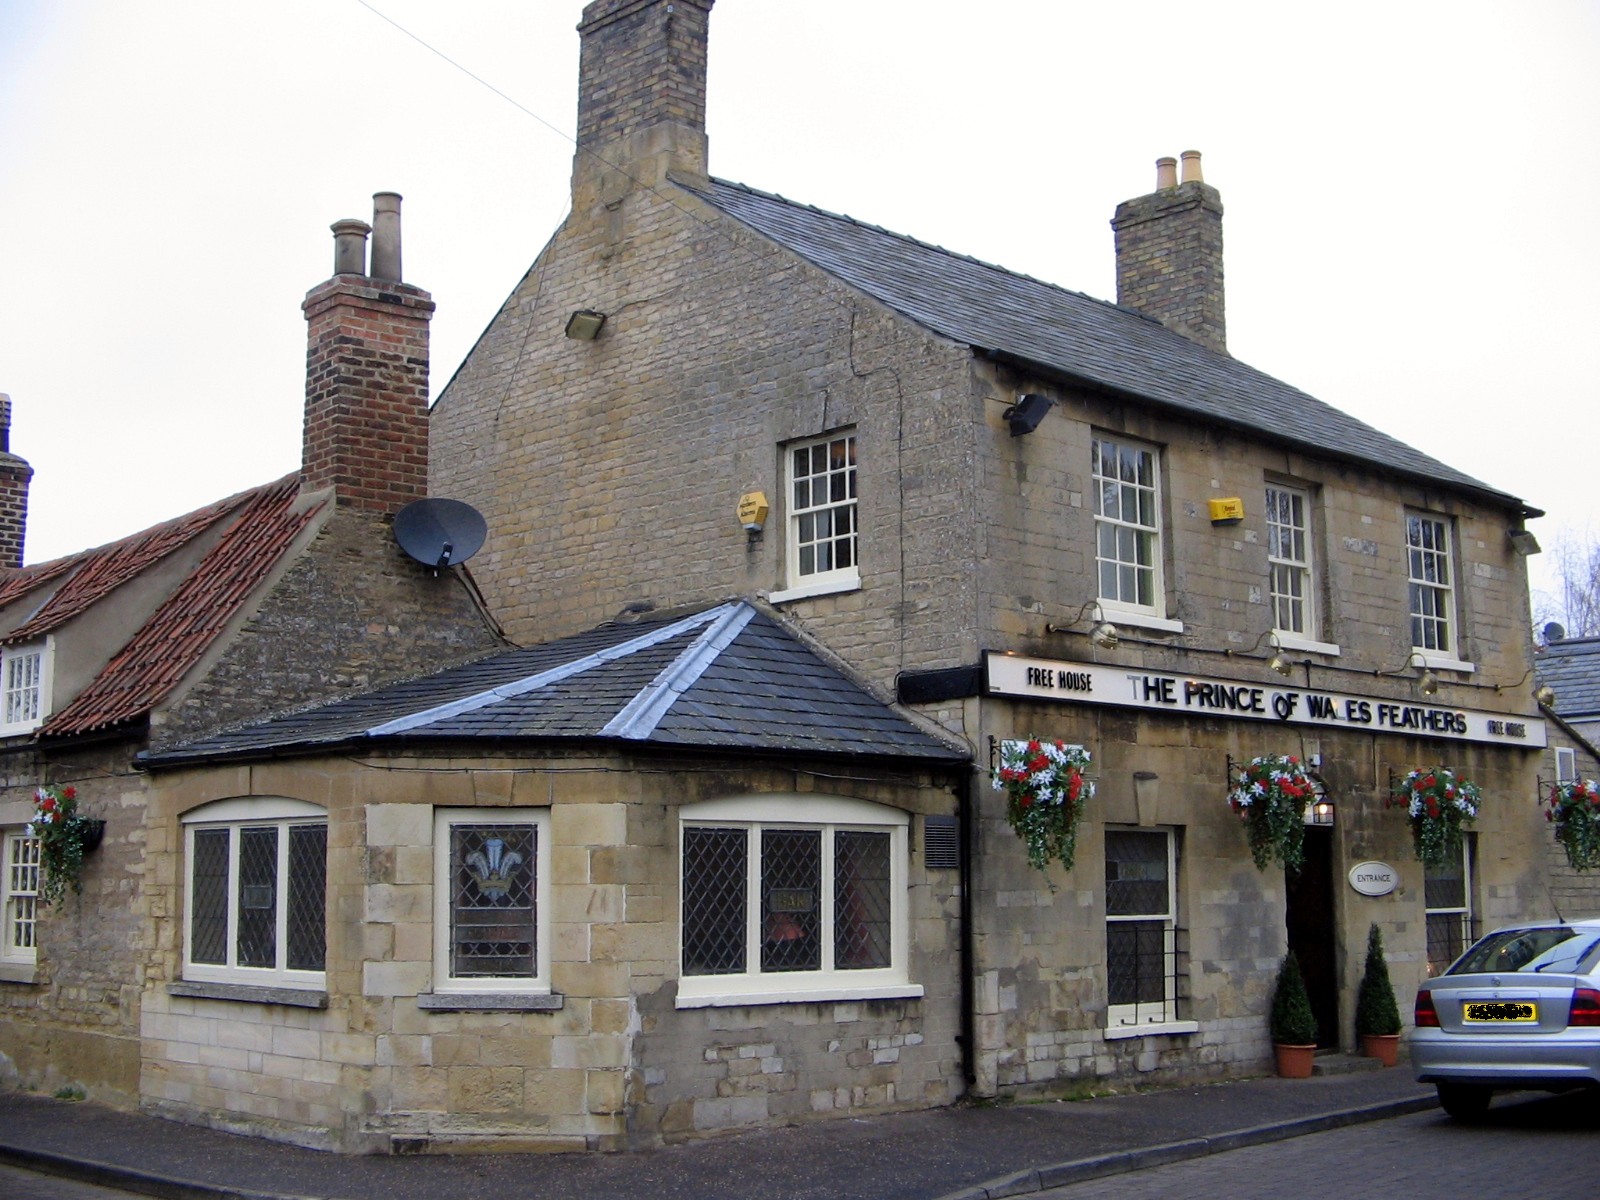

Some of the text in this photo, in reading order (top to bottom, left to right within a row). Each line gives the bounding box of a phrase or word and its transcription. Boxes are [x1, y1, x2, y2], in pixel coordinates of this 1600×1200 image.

[1027, 667, 1093, 692] FREE HOUSE
[1126, 674, 1178, 703] THE
[1184, 680, 1265, 713] PRINCE
[1271, 692, 1299, 720] OF
[1377, 703, 1467, 734] FEATHERS
[1487, 719, 1527, 738] FREE HOUSE
[1357, 874, 1391, 883] ENTRANCE
